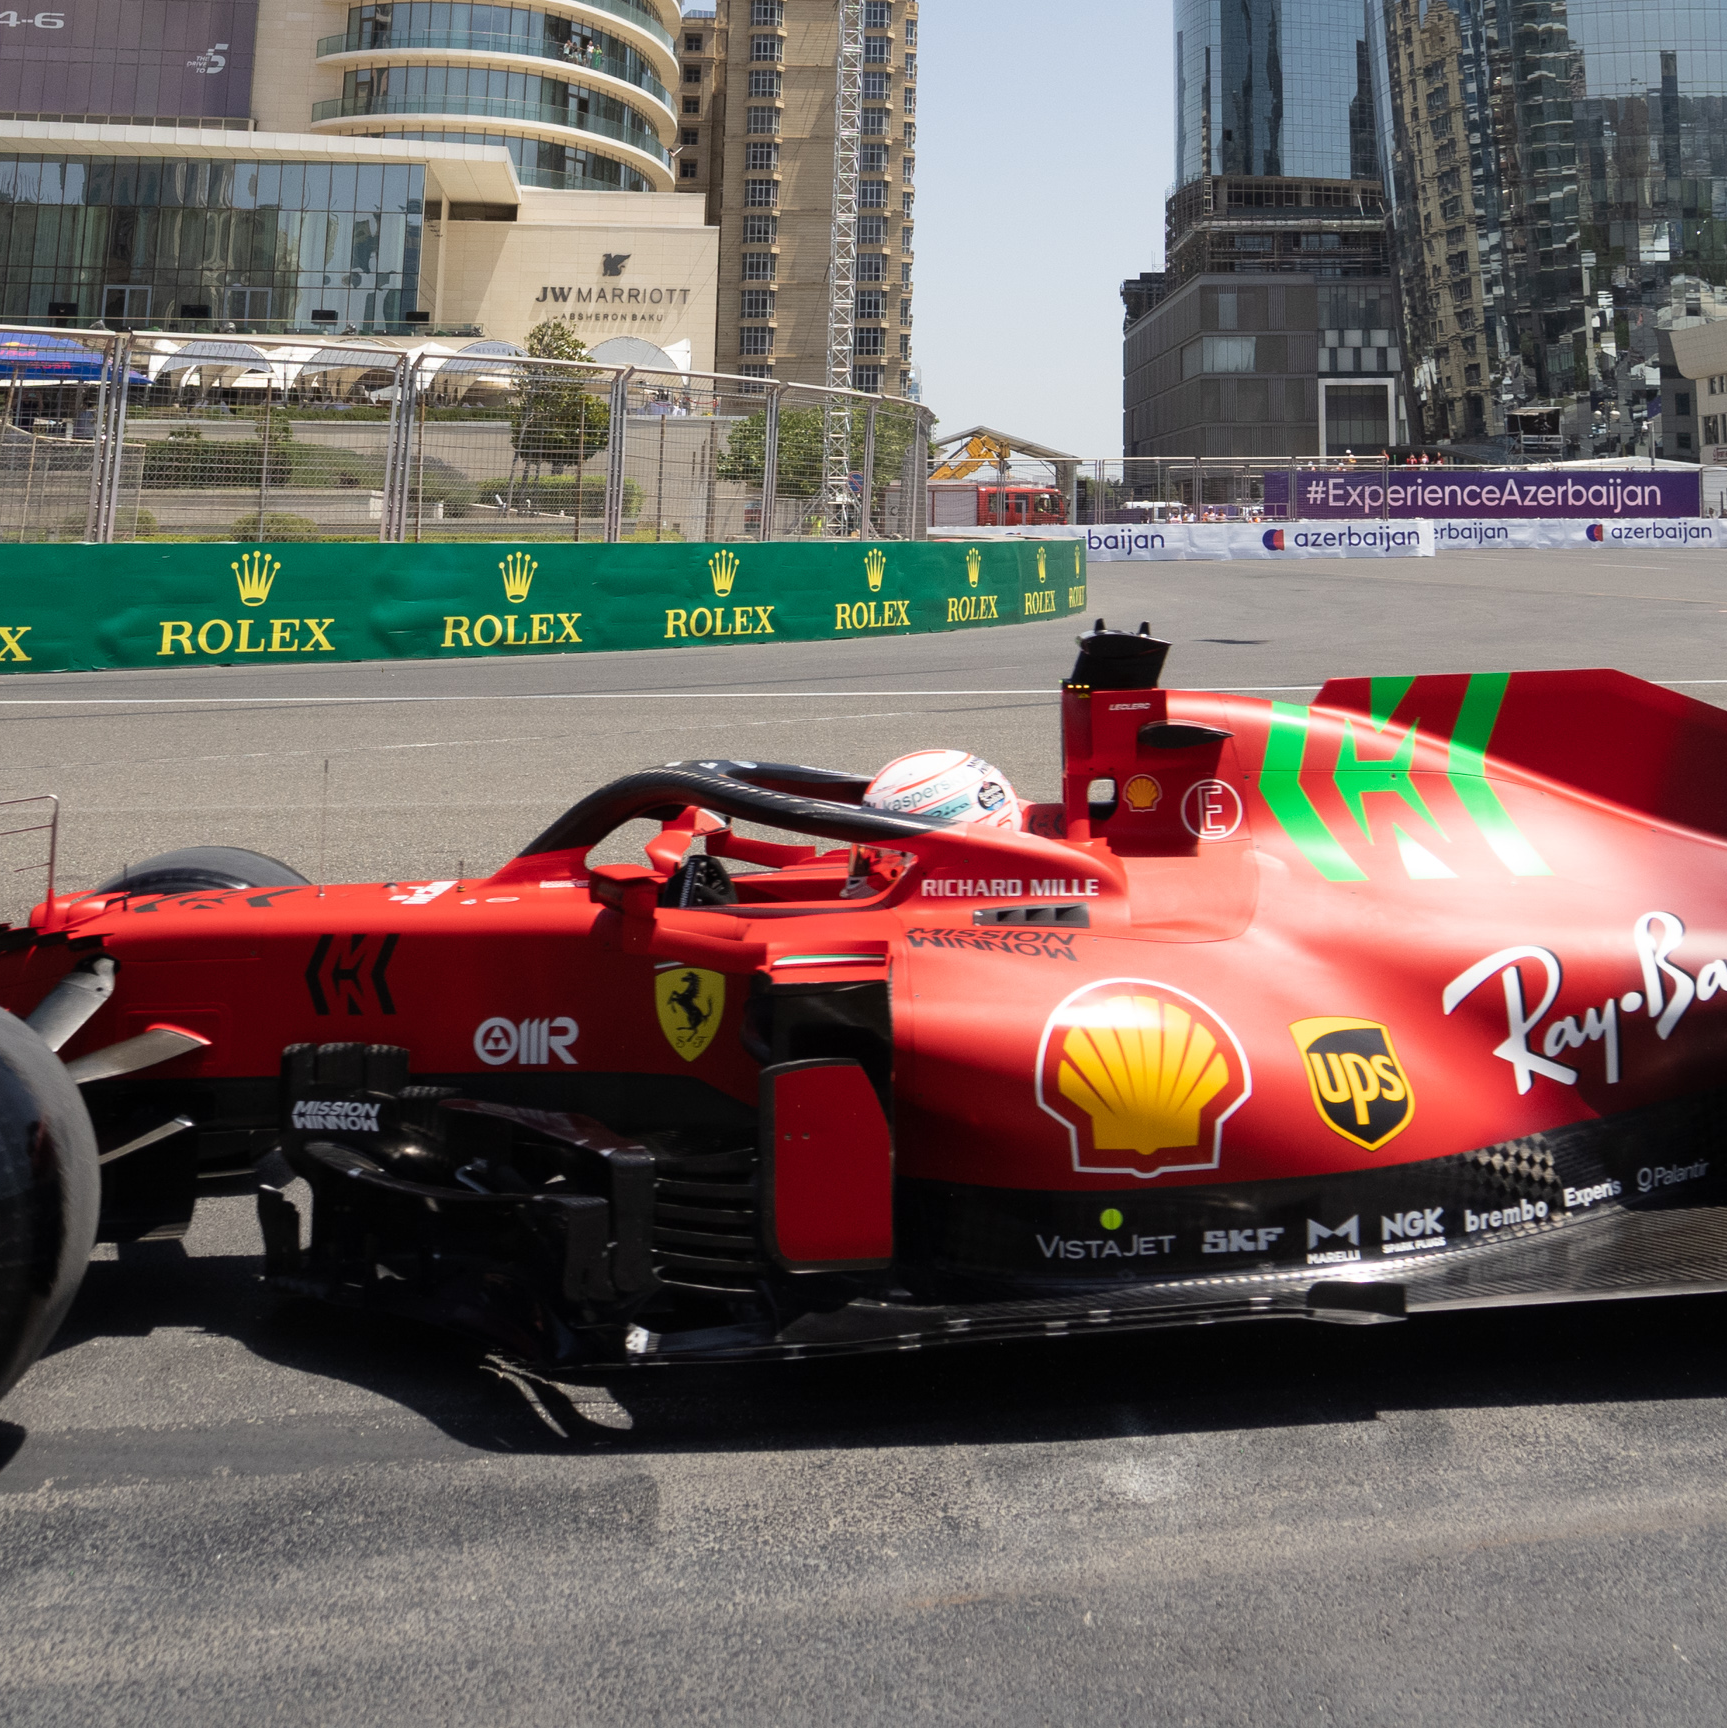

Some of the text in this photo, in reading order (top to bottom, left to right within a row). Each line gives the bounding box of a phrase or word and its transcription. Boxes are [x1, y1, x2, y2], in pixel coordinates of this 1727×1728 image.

[535, 286, 691, 305] JW MARRIOTT
[561, 312, 664, 323] ABSHERON BAKU
[1306, 476, 1662, 514] #ExperienceAzerbaijan
[1294, 524, 1420, 552] azerbaijan
[1611, 522, 1713, 545] azerbaijan
[834, 599, 911, 632] ROLEX
[947, 595, 999, 622] ROLEX
[1024, 590, 1056, 615] ROLEX
[440, 612, 583, 648] ROLEX
[664, 604, 775, 639] ROLEX
[156, 617, 336, 656] ROLEX
[1108, 702, 1152, 711] LECLERC
[1197, 785, 1227, 834] E
[921, 878, 1100, 897] RICHARD MILLE
[906, 927, 1076, 946] MISSION
[906, 934, 1080, 963] WINNOW
[1307, 1048, 1408, 1125] ups
[292, 1100, 381, 1118] MISSION
[291, 1115, 380, 1132] WINNOW
[1652, 1158, 1711, 1190] Palantir
[1563, 1177, 1622, 1211] Experis
[1381, 1206, 1445, 1240] NGK
[1464, 1198, 1549, 1234] brembo
[1202, 1226, 1285, 1254] SKF
[1381, 1235, 1447, 1255] SPARK PLUGS
[1306, 1248, 1361, 1266] MARELLI
